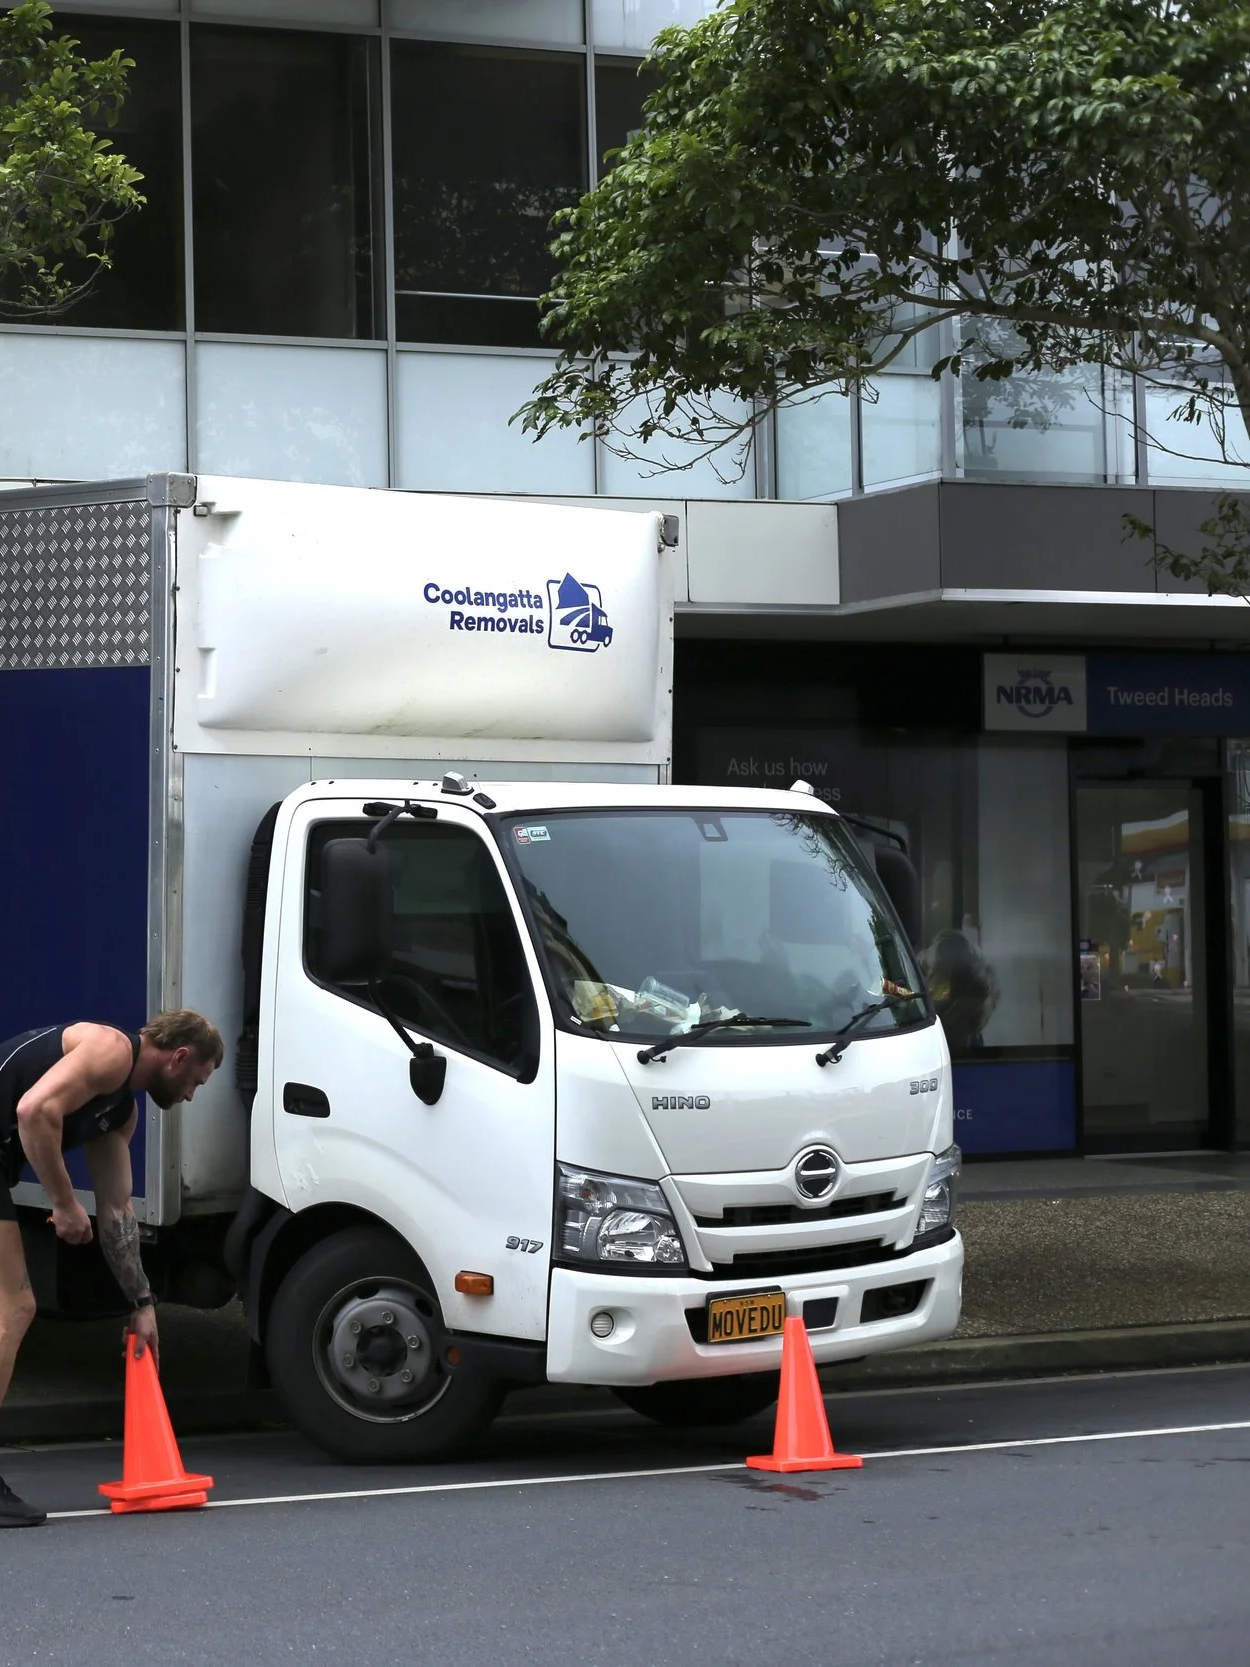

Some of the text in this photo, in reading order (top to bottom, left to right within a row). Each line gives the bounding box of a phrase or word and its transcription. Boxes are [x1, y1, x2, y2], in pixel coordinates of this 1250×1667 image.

[423, 582, 543, 613] Coolangatta
[449, 611, 544, 635] Removals
[996, 685, 1074, 706] NRMA
[1106, 686, 1233, 707] Tweed Heads
[726, 756, 828, 776] Ask us how
[909, 1078, 939, 1095] 300
[652, 1095, 711, 1110] HINO
[505, 1235, 544, 1254] 917
[712, 1303, 782, 1338] MOVEDU
